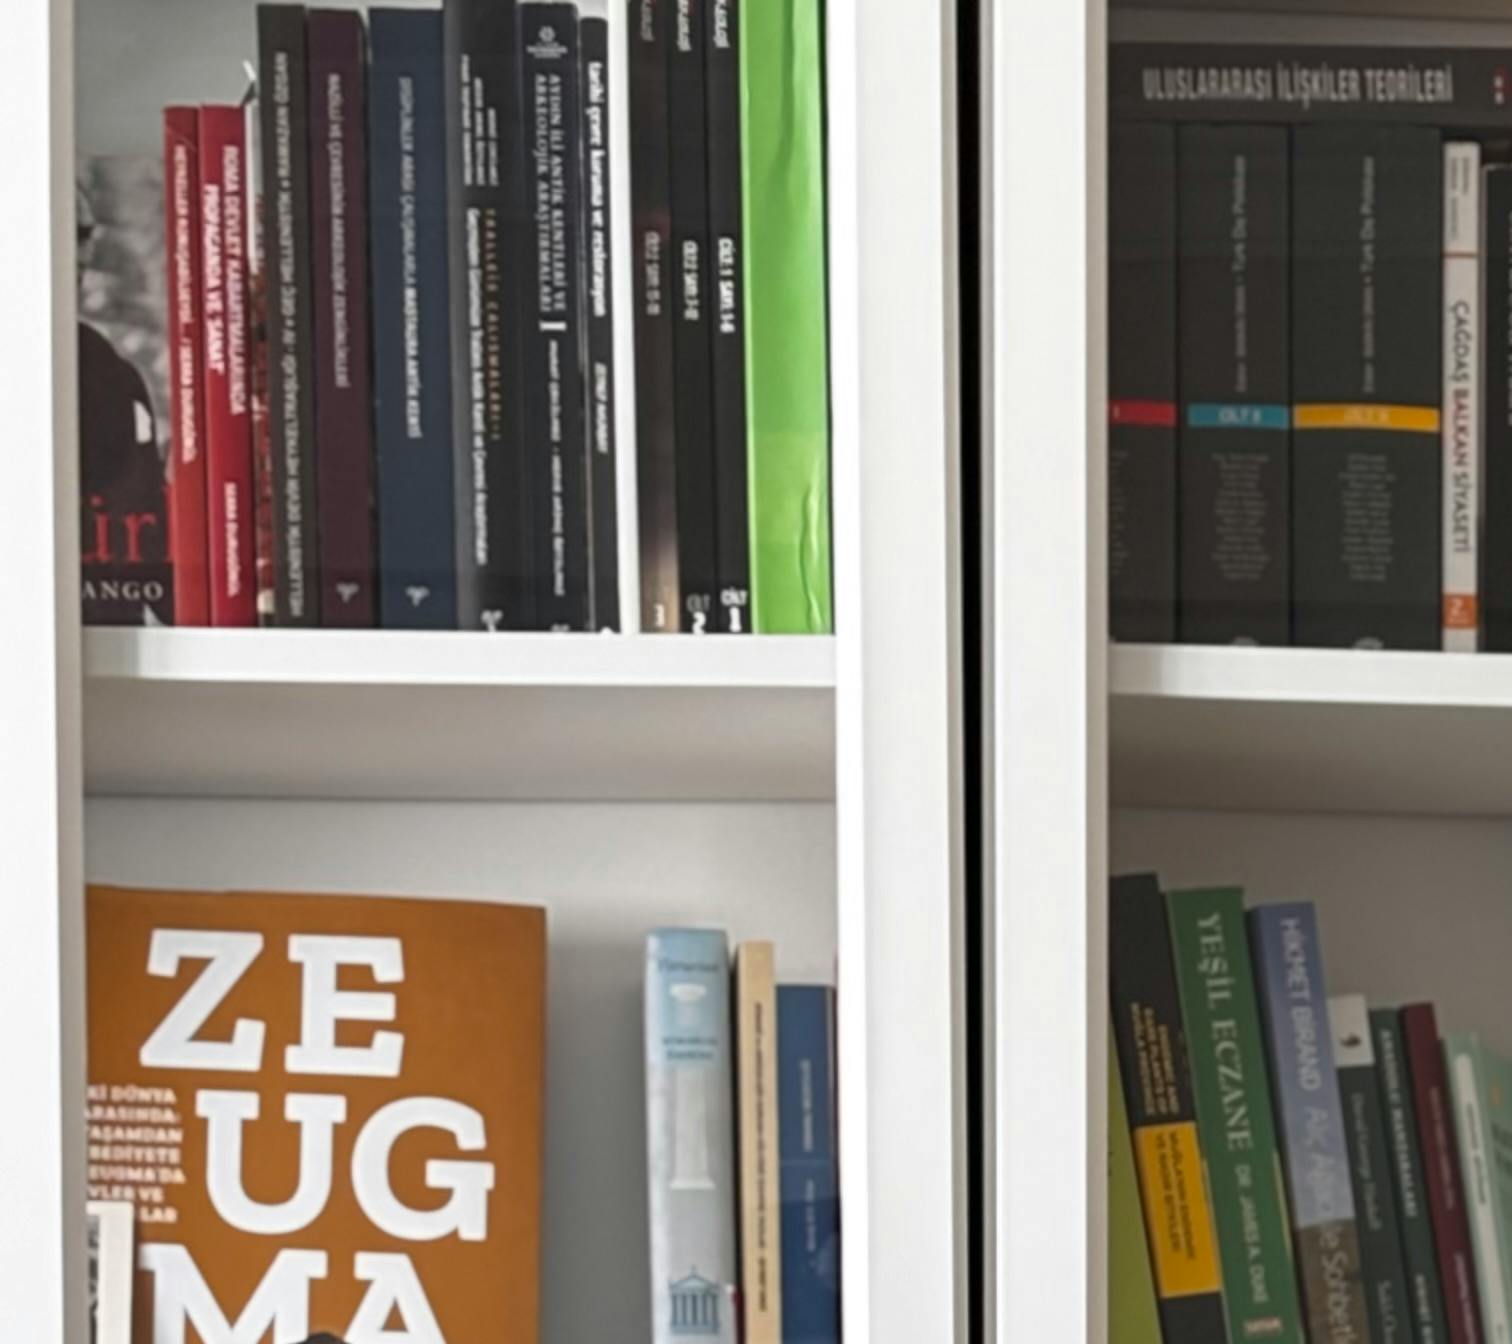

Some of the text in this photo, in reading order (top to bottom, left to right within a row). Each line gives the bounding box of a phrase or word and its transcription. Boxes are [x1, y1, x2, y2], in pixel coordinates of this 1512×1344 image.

[549, 75, 563, 126] AYDIN
[1143, 61, 1453, 111] ULUSLARARASI İLİŞKİLER TEORİLERİ
[534, 75, 551, 177] ARKEOLOJİK
[550, 155, 565, 204] ANTİK
[586, 63, 607, 317] tarihi çevre koruma ve restorasyon
[1448, 301, 1472, 554] ÇAĞDAŞ BALKAN SİYASETİ
[83, 580, 164, 600] ANGO
[1280, 918, 1311, 1000] HİKMET
[140, 927, 405, 1077] ZE
[1197, 912, 1254, 1152] YEŞİL ECZANE
[110, 1084, 177, 1104] DÜNYA
[89, 1145, 181, 1164] BEDİYETE
[90, 1125, 184, 1143] AŞAMDAN
[88, 1164, 186, 1184] EUGMA'DA
[196, 1090, 494, 1240] UG
[88, 1185, 165, 1203] VLER VE
